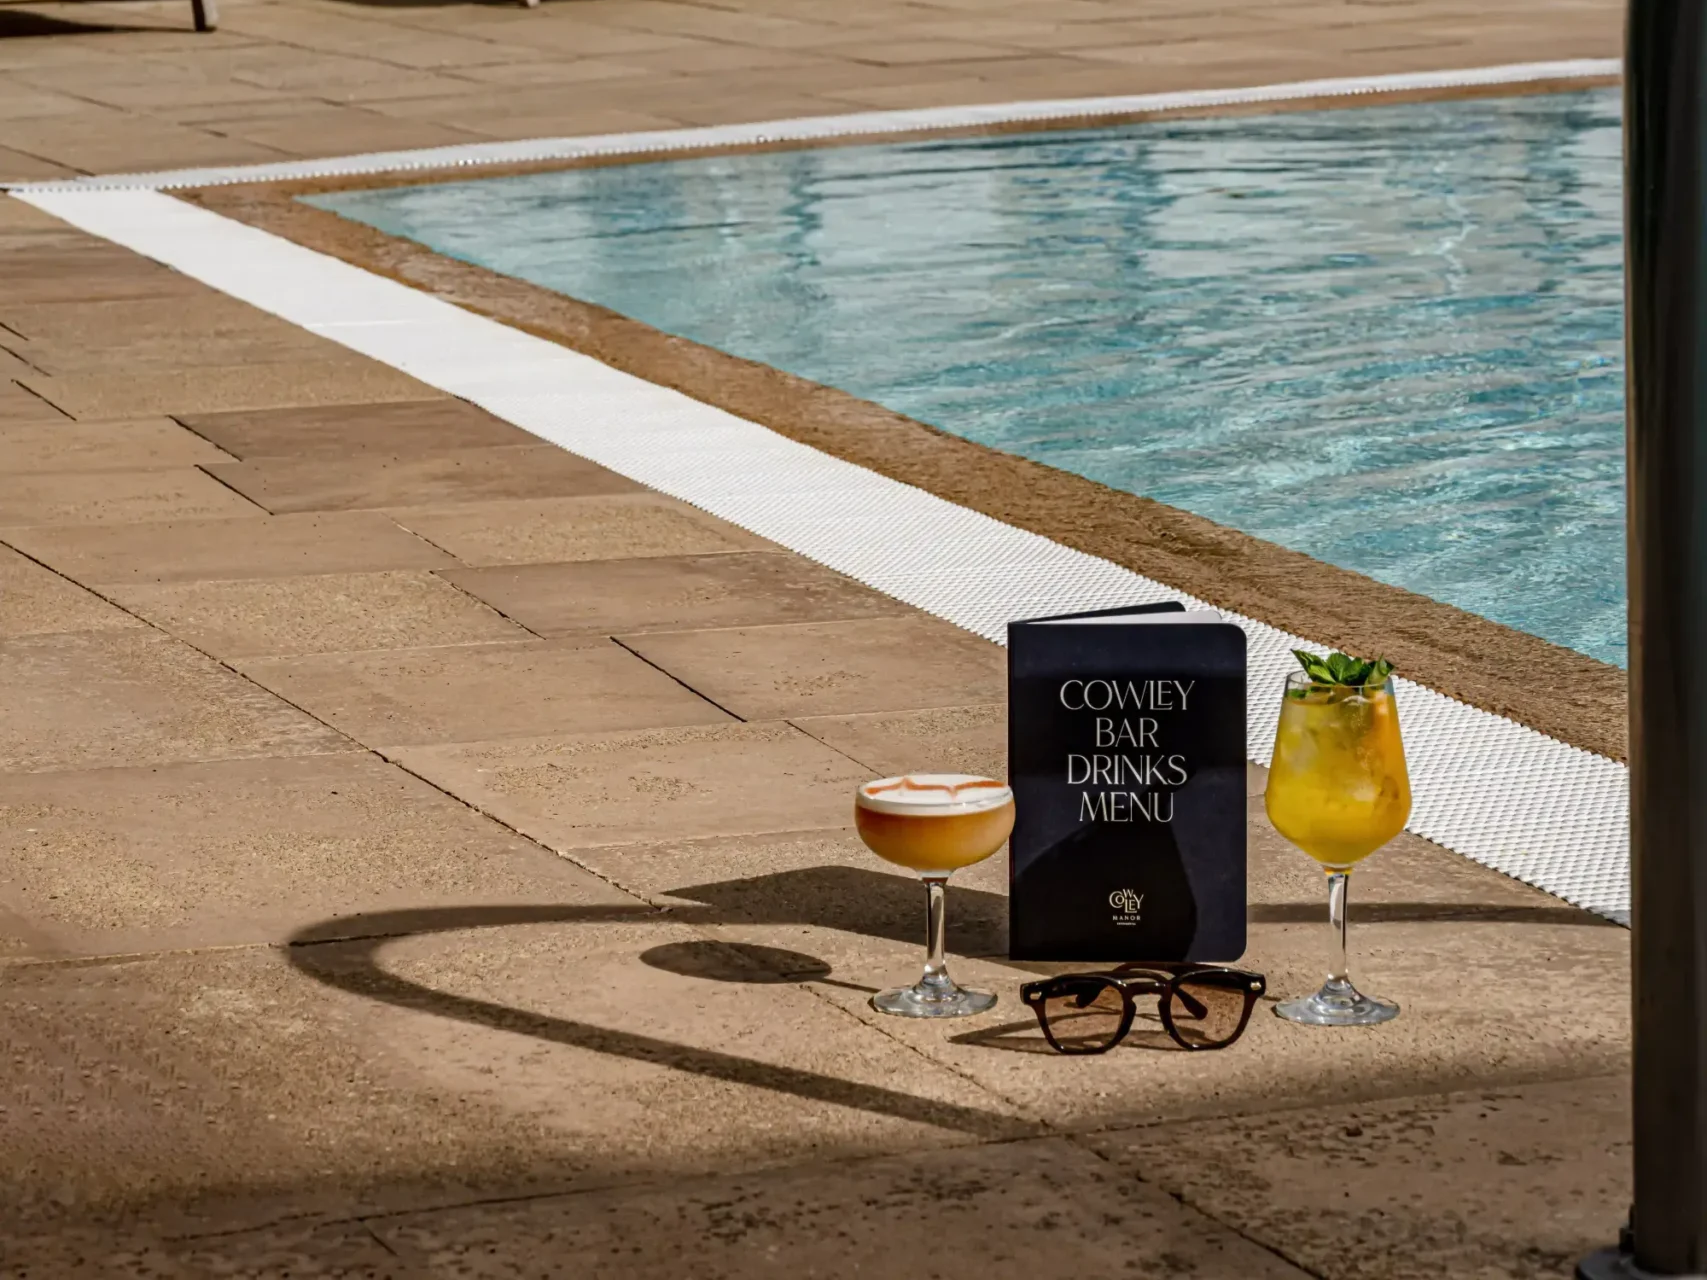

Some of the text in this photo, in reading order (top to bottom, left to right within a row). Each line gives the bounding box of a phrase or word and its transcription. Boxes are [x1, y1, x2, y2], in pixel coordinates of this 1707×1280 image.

[1060, 679, 1195, 710] COWLEY
[1096, 717, 1160, 747] BAR
[1067, 754, 1187, 785] DRINKS
[1079, 791, 1174, 822] MENU
